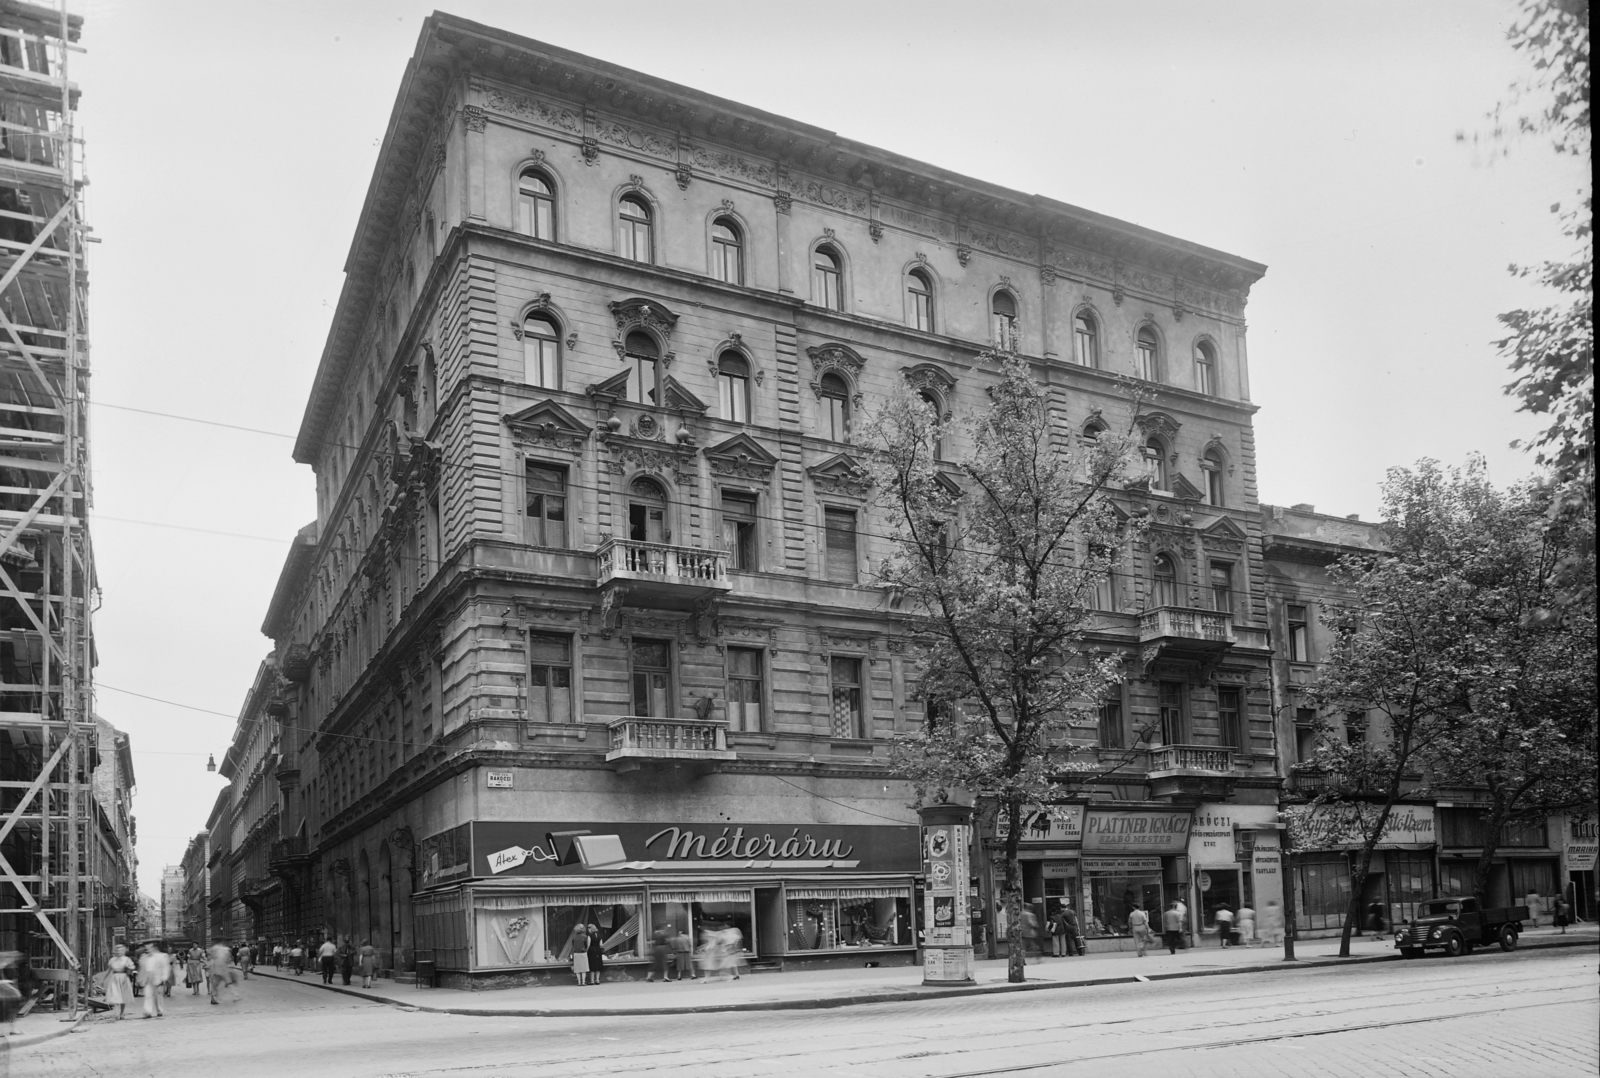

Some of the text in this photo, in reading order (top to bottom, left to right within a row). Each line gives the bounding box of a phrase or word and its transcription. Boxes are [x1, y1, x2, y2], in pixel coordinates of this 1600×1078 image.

[1087, 814, 1188, 834] PLATTNER IGNÁCZ
[645, 827, 853, 859] Méteráru
[1098, 833, 1172, 843] SZABÓ MESTER
[1568, 846, 1598, 854] MARIKA
